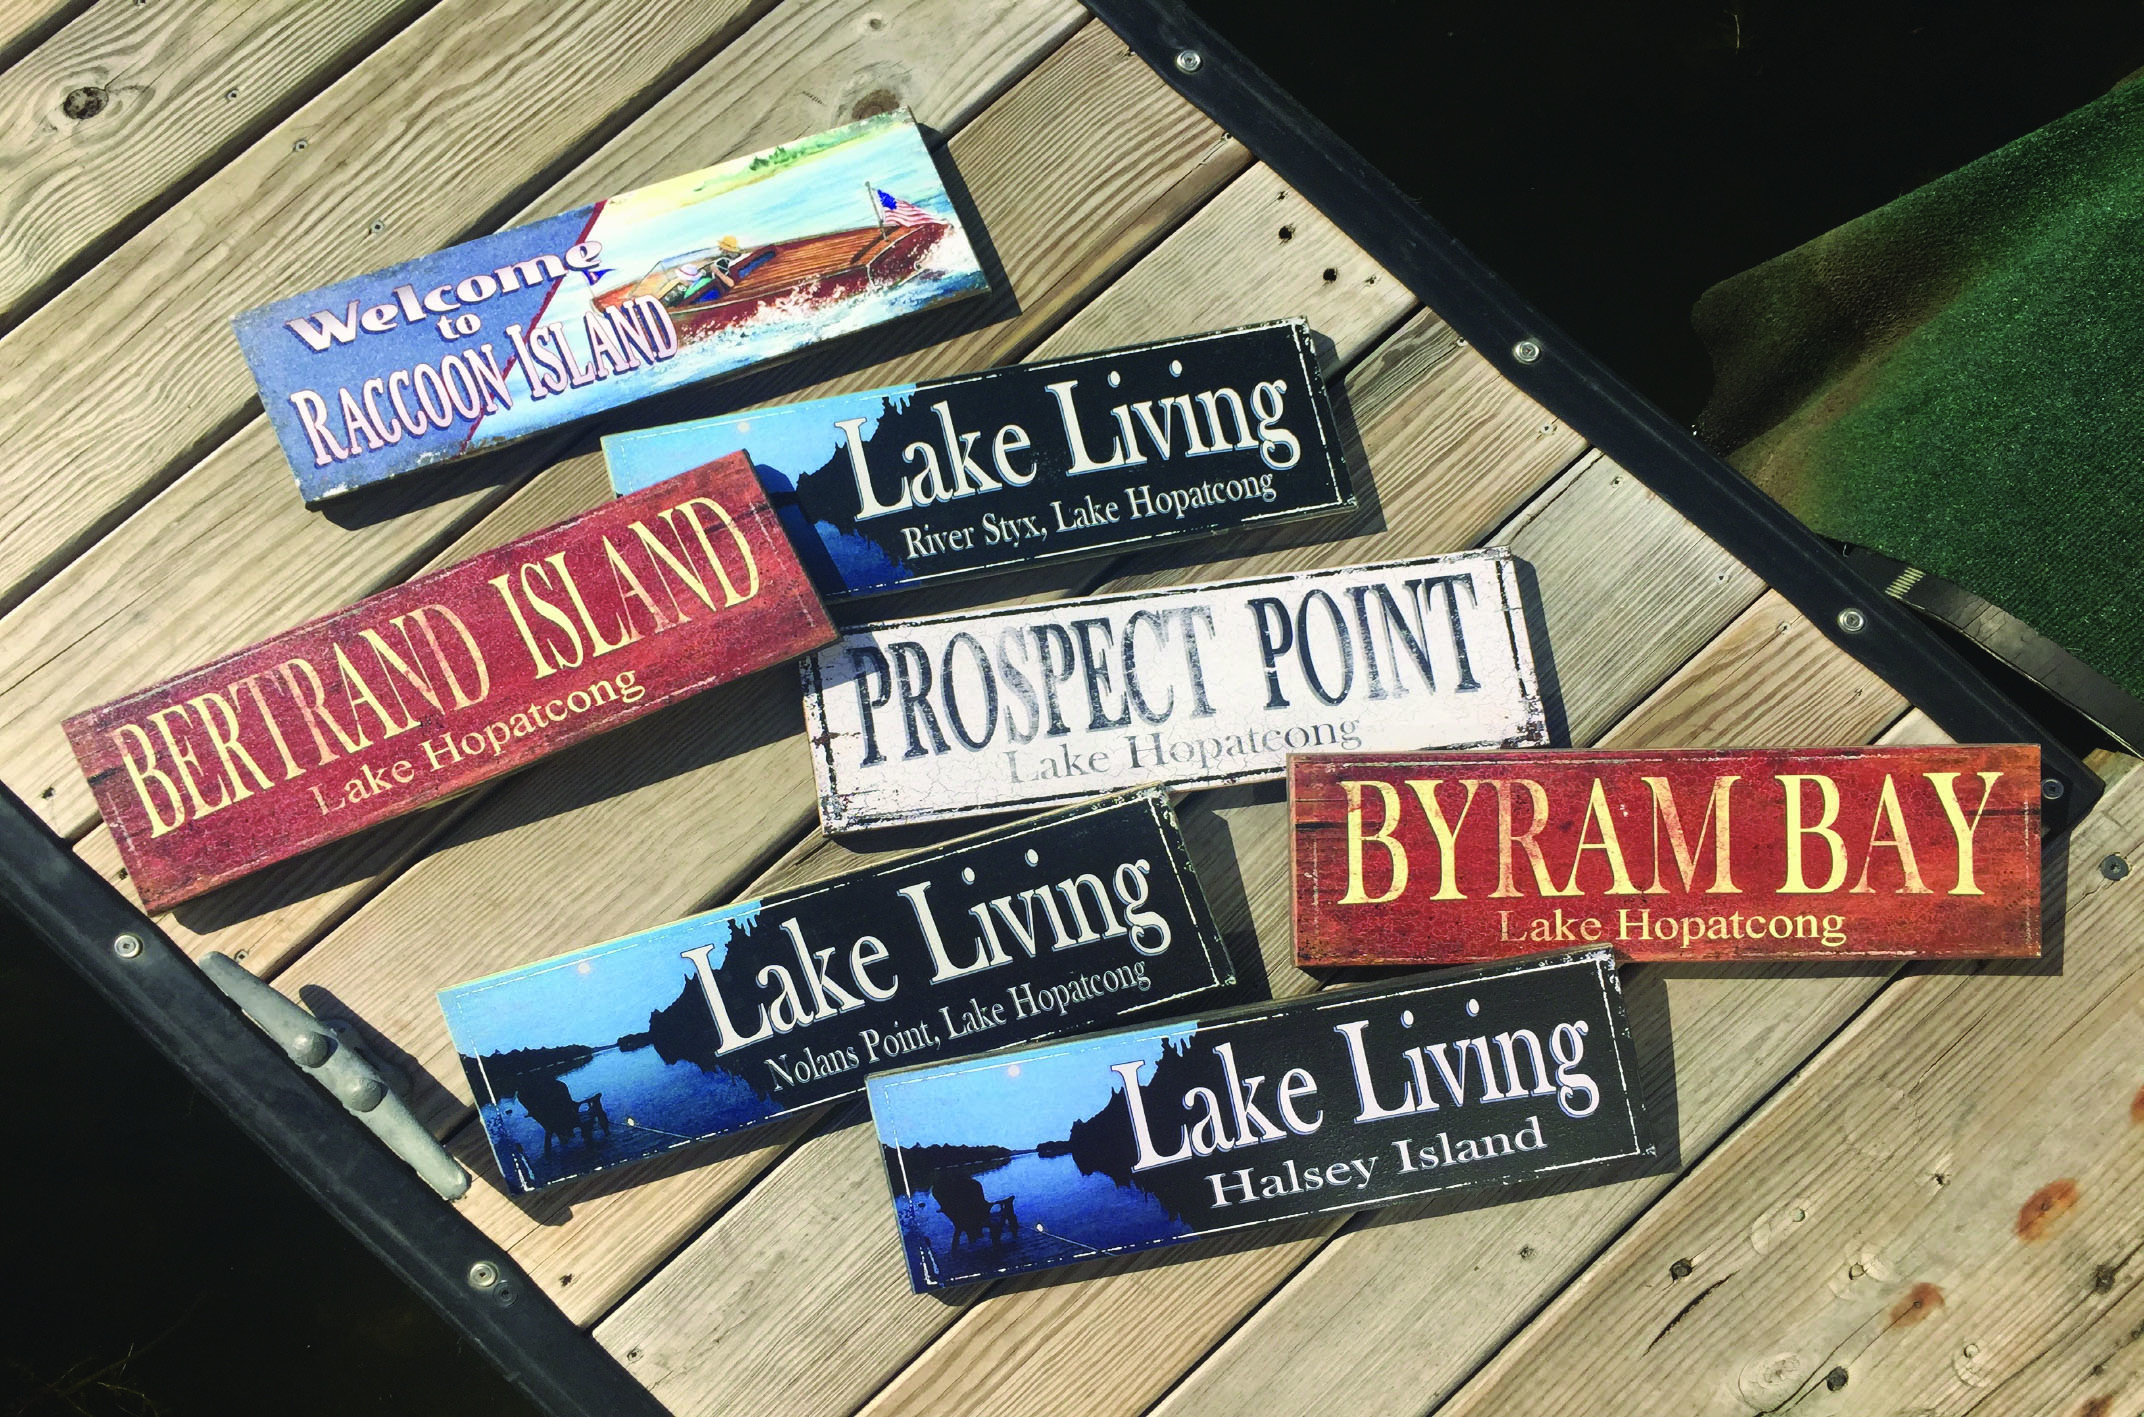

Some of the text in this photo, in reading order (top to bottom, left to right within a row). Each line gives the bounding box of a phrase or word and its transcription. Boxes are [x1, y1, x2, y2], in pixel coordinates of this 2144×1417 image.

[285, 239, 603, 353] Welcome
[436, 309, 482, 340] to
[290, 294, 679, 468] RACCOON ISLAND
[834, 360, 1301, 522] Lake Living
[902, 473, 1277, 560] River Styx, Lake Hopatcong
[114, 496, 761, 838] BERTRAND ISLAND
[853, 572, 1481, 768] PROSPECT POINT
[312, 664, 645, 816] Lake Hopatcong
[1003, 717, 1362, 784] Lake Hopatcong
[1337, 771, 2003, 905] BYRAM BAY
[681, 849, 1171, 1057] Lake Living
[1501, 909, 1846, 946] Lake Hopatcong
[765, 961, 1151, 1092] Nolans Point, Lake Hopatcong
[1111, 998, 1601, 1173] Lake Living
[1205, 1115, 1547, 1208] Halsey Island
